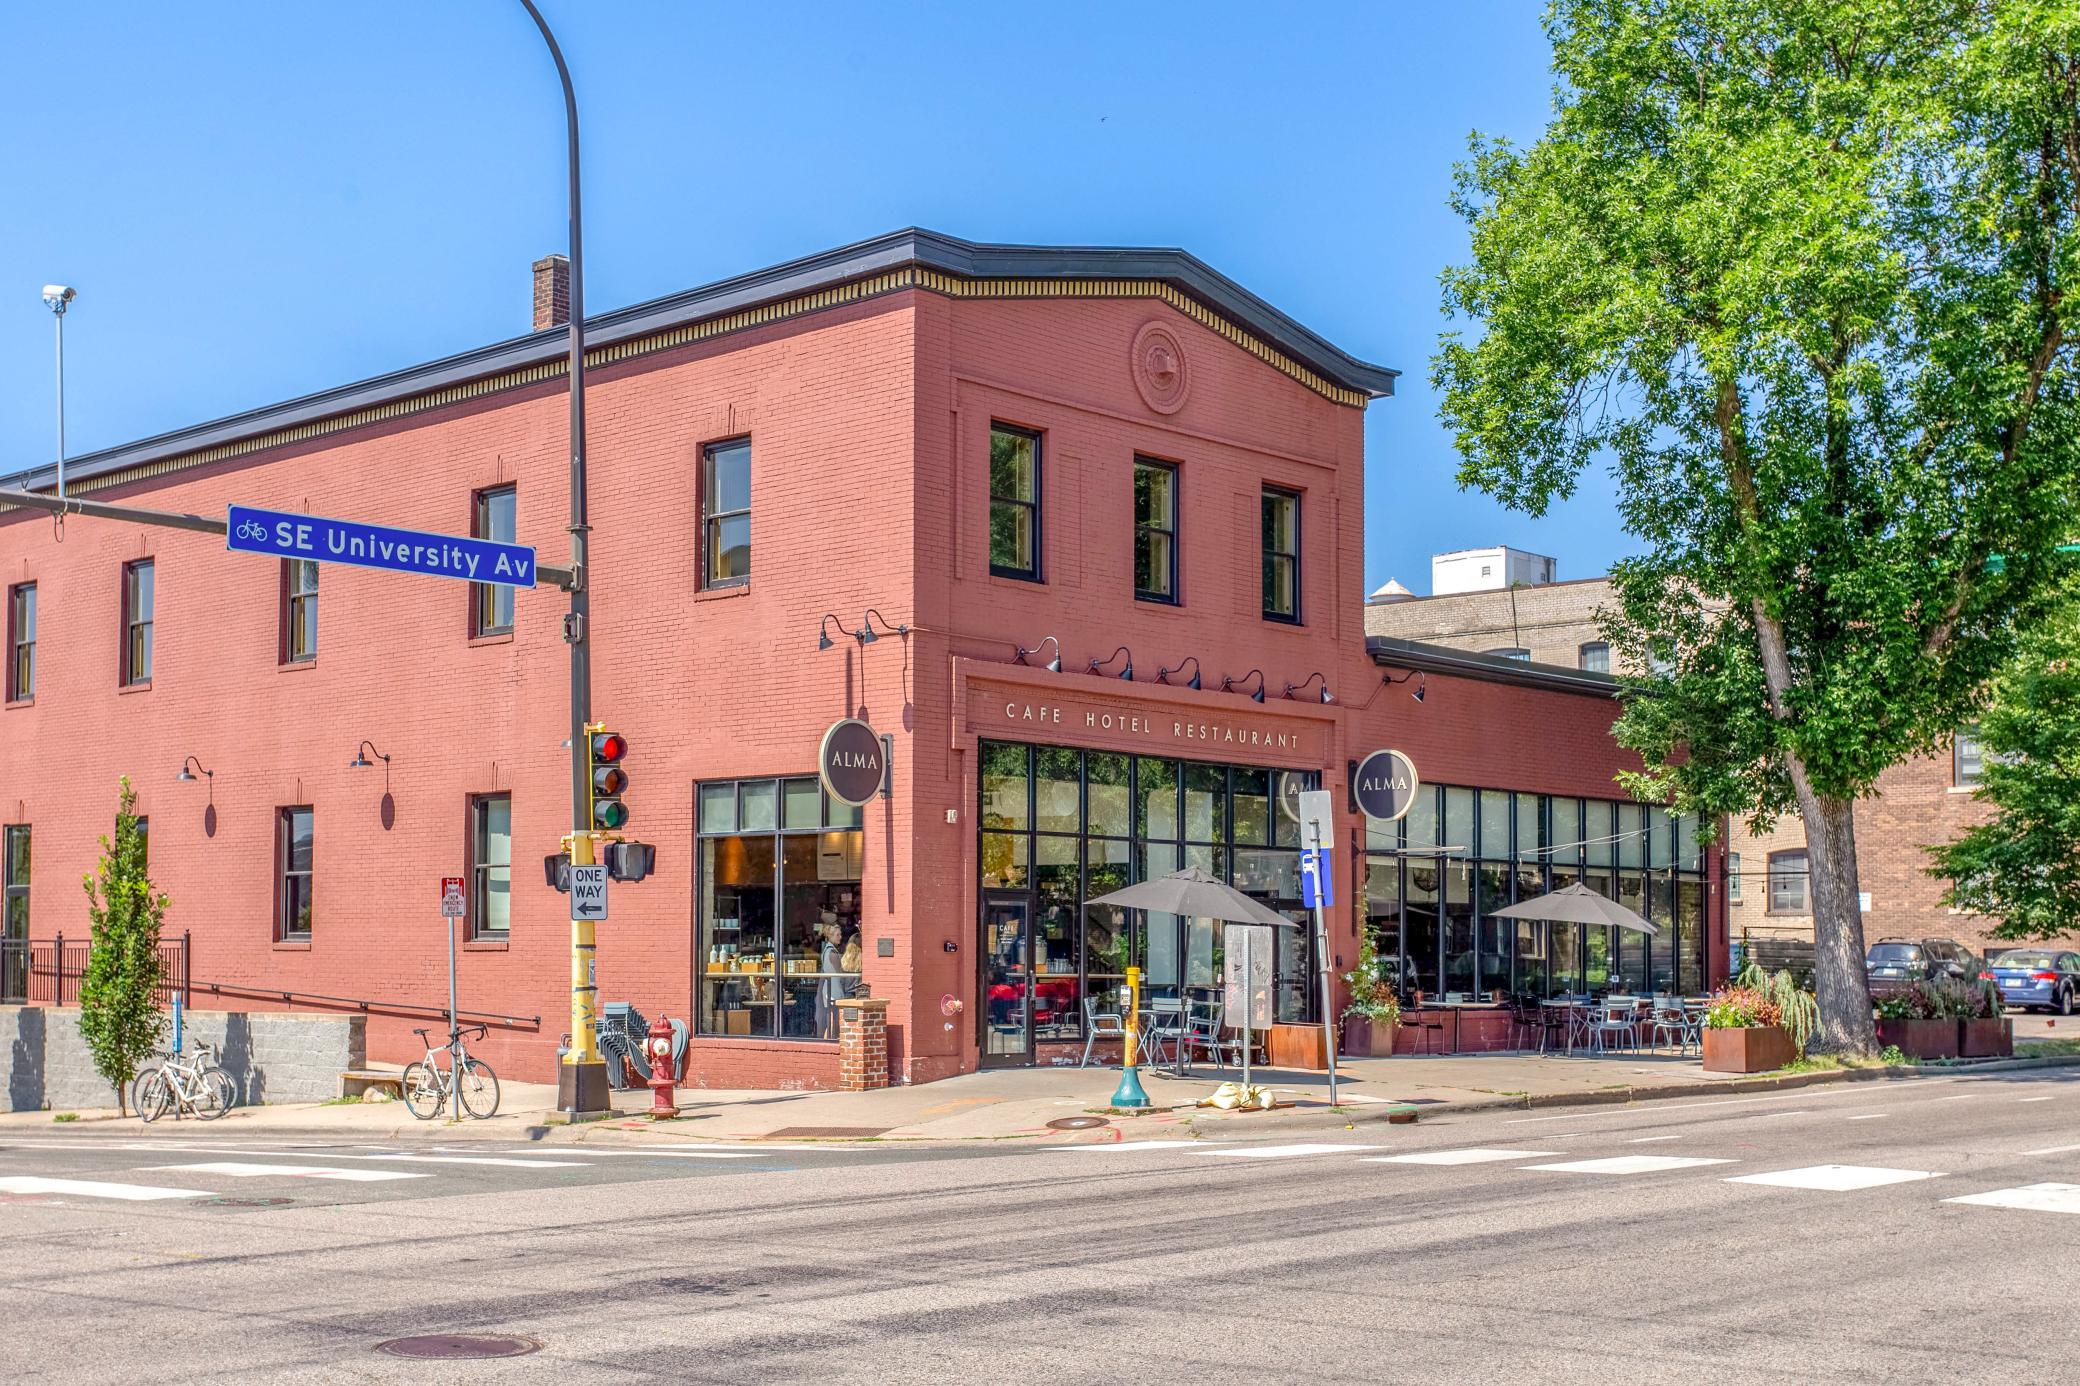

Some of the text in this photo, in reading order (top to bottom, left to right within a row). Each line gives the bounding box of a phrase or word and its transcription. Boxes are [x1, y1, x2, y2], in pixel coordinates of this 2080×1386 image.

[275, 521, 529, 578] SE University Av
[1005, 703, 1297, 748] CAFE HOTEL RESTAURANT
[832, 751, 878, 769] ALMA
[1363, 776, 1408, 791] ALMA
[576, 869, 602, 882] ONE
[575, 885, 602, 898] WAY
